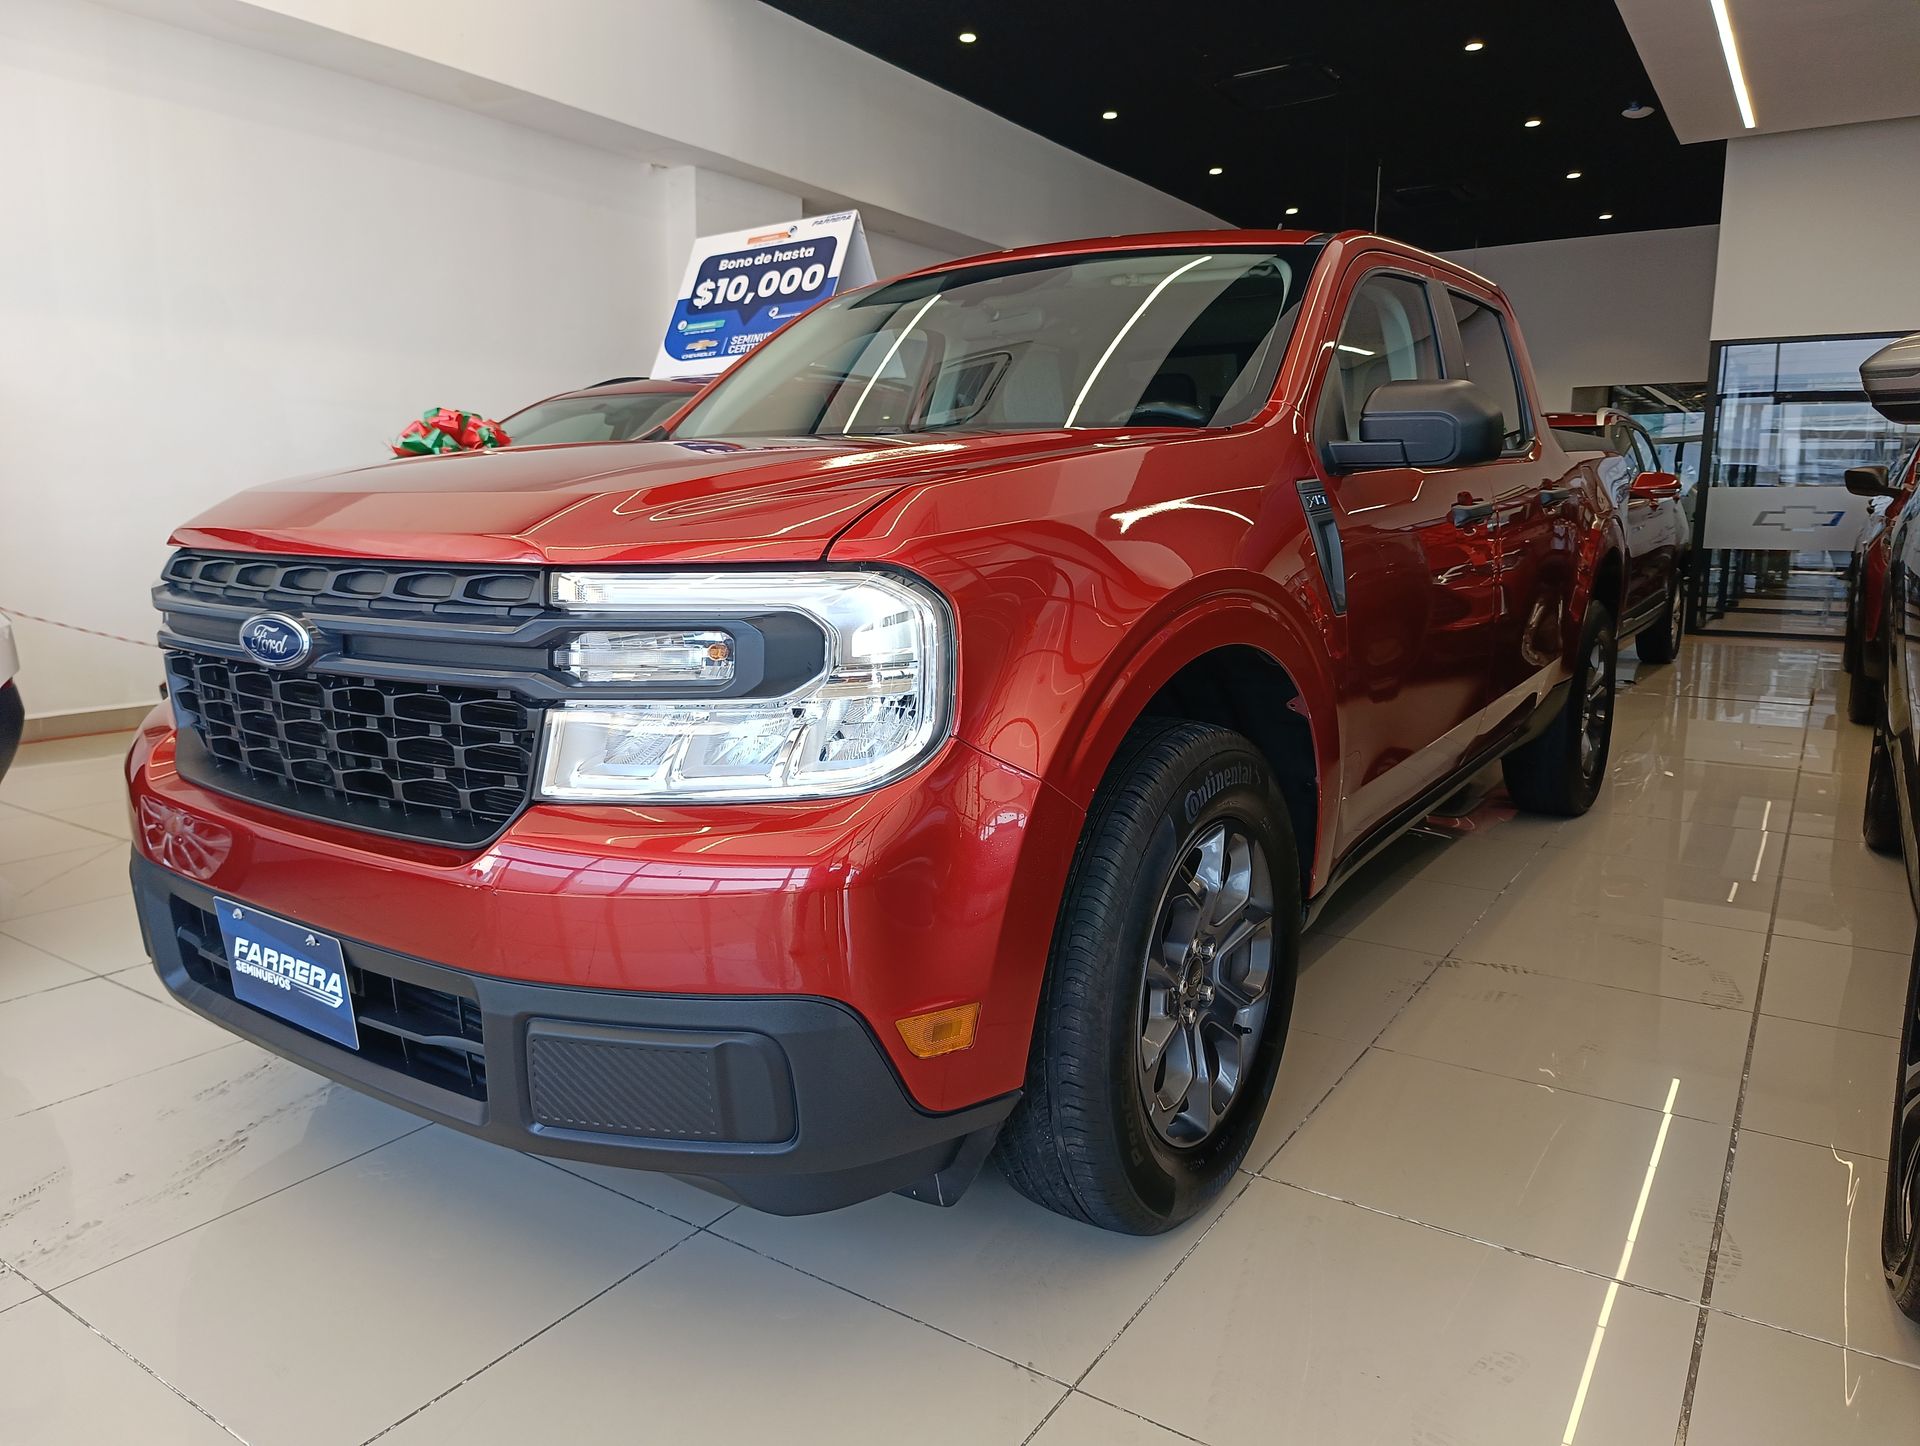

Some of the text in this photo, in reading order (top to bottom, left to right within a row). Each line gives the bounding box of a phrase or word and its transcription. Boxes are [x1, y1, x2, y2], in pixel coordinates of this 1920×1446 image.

[718, 246, 816, 271] Bono de hasta
[692, 263, 826, 309] $10,000
[251, 624, 289, 654] Ford
[1184, 760, 1253, 825] Continental
[233, 936, 344, 998] FARRERA
[235, 959, 292, 991] SEMINUEVOS
